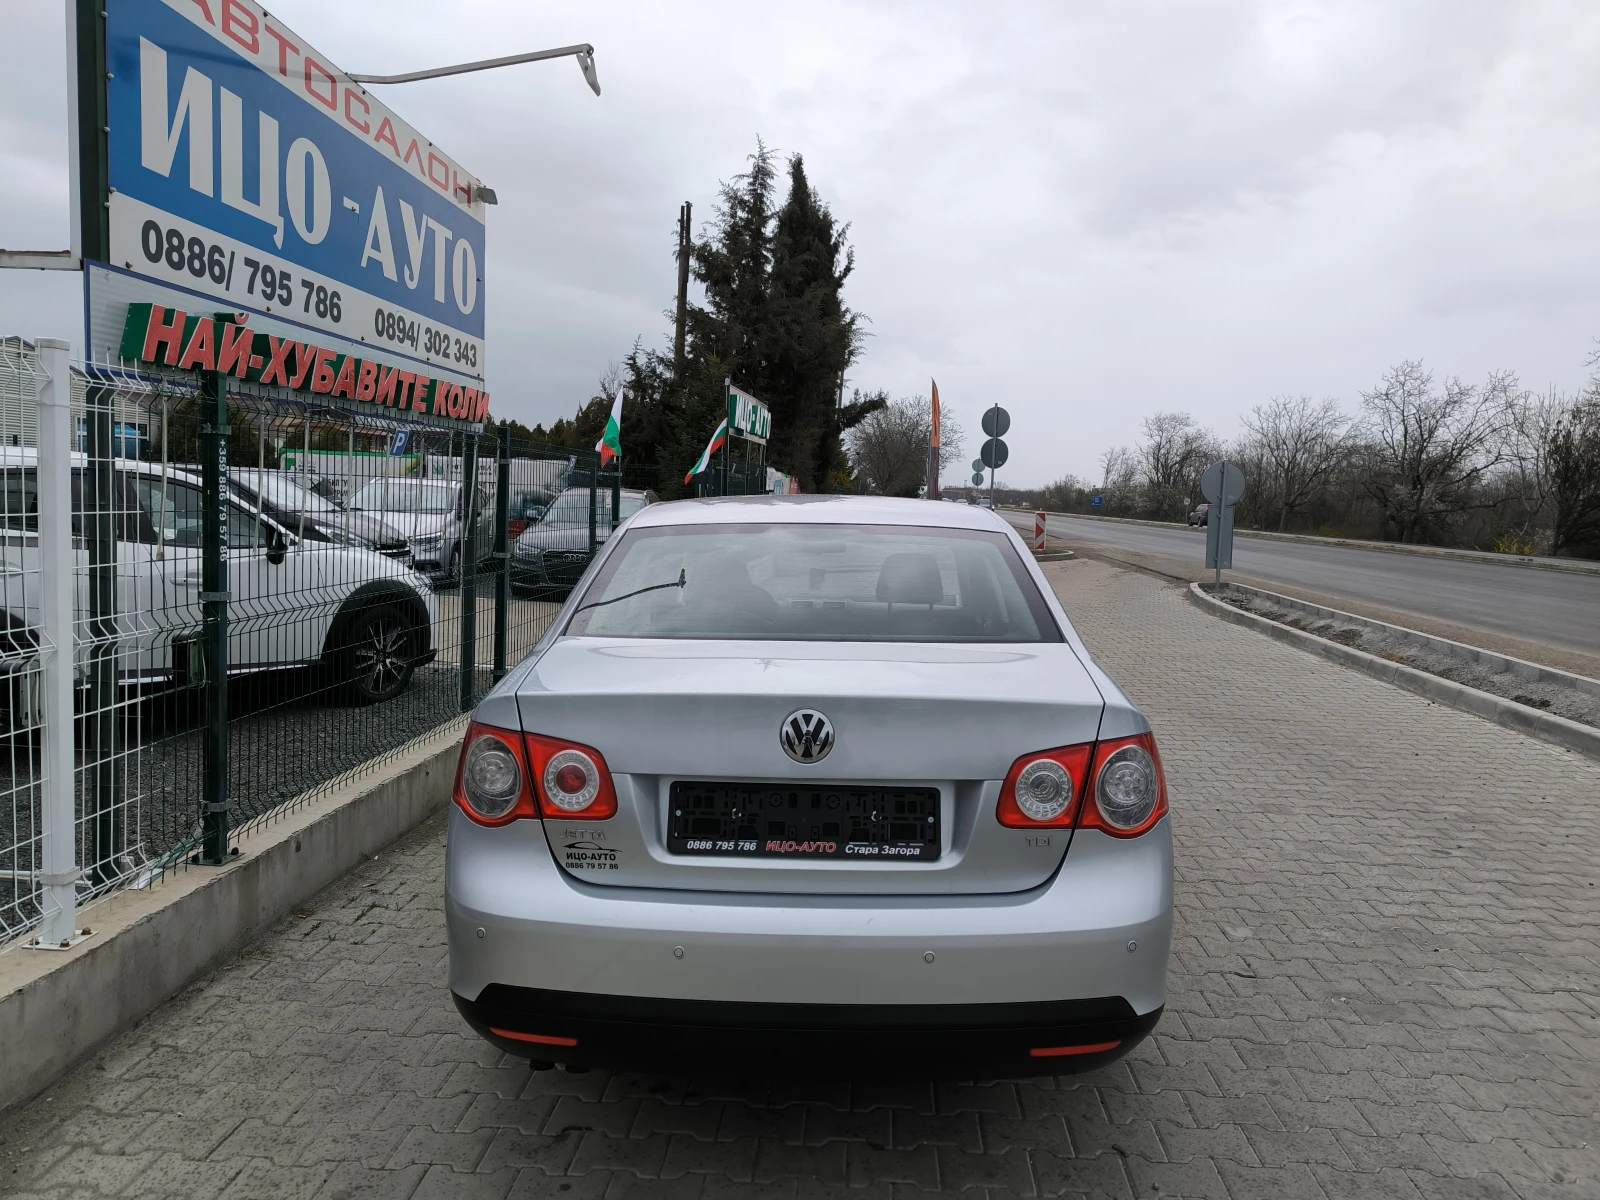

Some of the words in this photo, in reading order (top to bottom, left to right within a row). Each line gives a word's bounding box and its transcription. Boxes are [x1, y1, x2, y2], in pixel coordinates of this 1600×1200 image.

[141, 219, 235, 292] 0886/
[244, 256, 293, 307] 795
[301, 278, 342, 324] 786
[374, 307, 421, 352] 0894/
[424, 326, 451, 360] 302
[454, 337, 477, 368] 343
[141, 302, 430, 413] НАЙ-ХУБАВИТЕ
[433, 379, 490, 424] КОЛИ
[218, 438, 227, 472] +359
[218, 475, 227, 501] 886
[218, 504, 227, 521] 79
[219, 525, 227, 541] 57
[219, 545, 227, 562] 86
[558, 829, 606, 840] JETTA
[1025, 835, 1052, 847] TDI
[566, 852, 616, 861] ИЦО-АУТО
[686, 840, 713, 851] 0886
[715, 841, 735, 851] 795
[737, 841, 757, 852] 786
[765, 840, 837, 853] ИЦО-АУТО
[845, 844, 879, 856] Стара
[881, 845, 921, 857] Загора
[597, 862, 607, 870] 57
